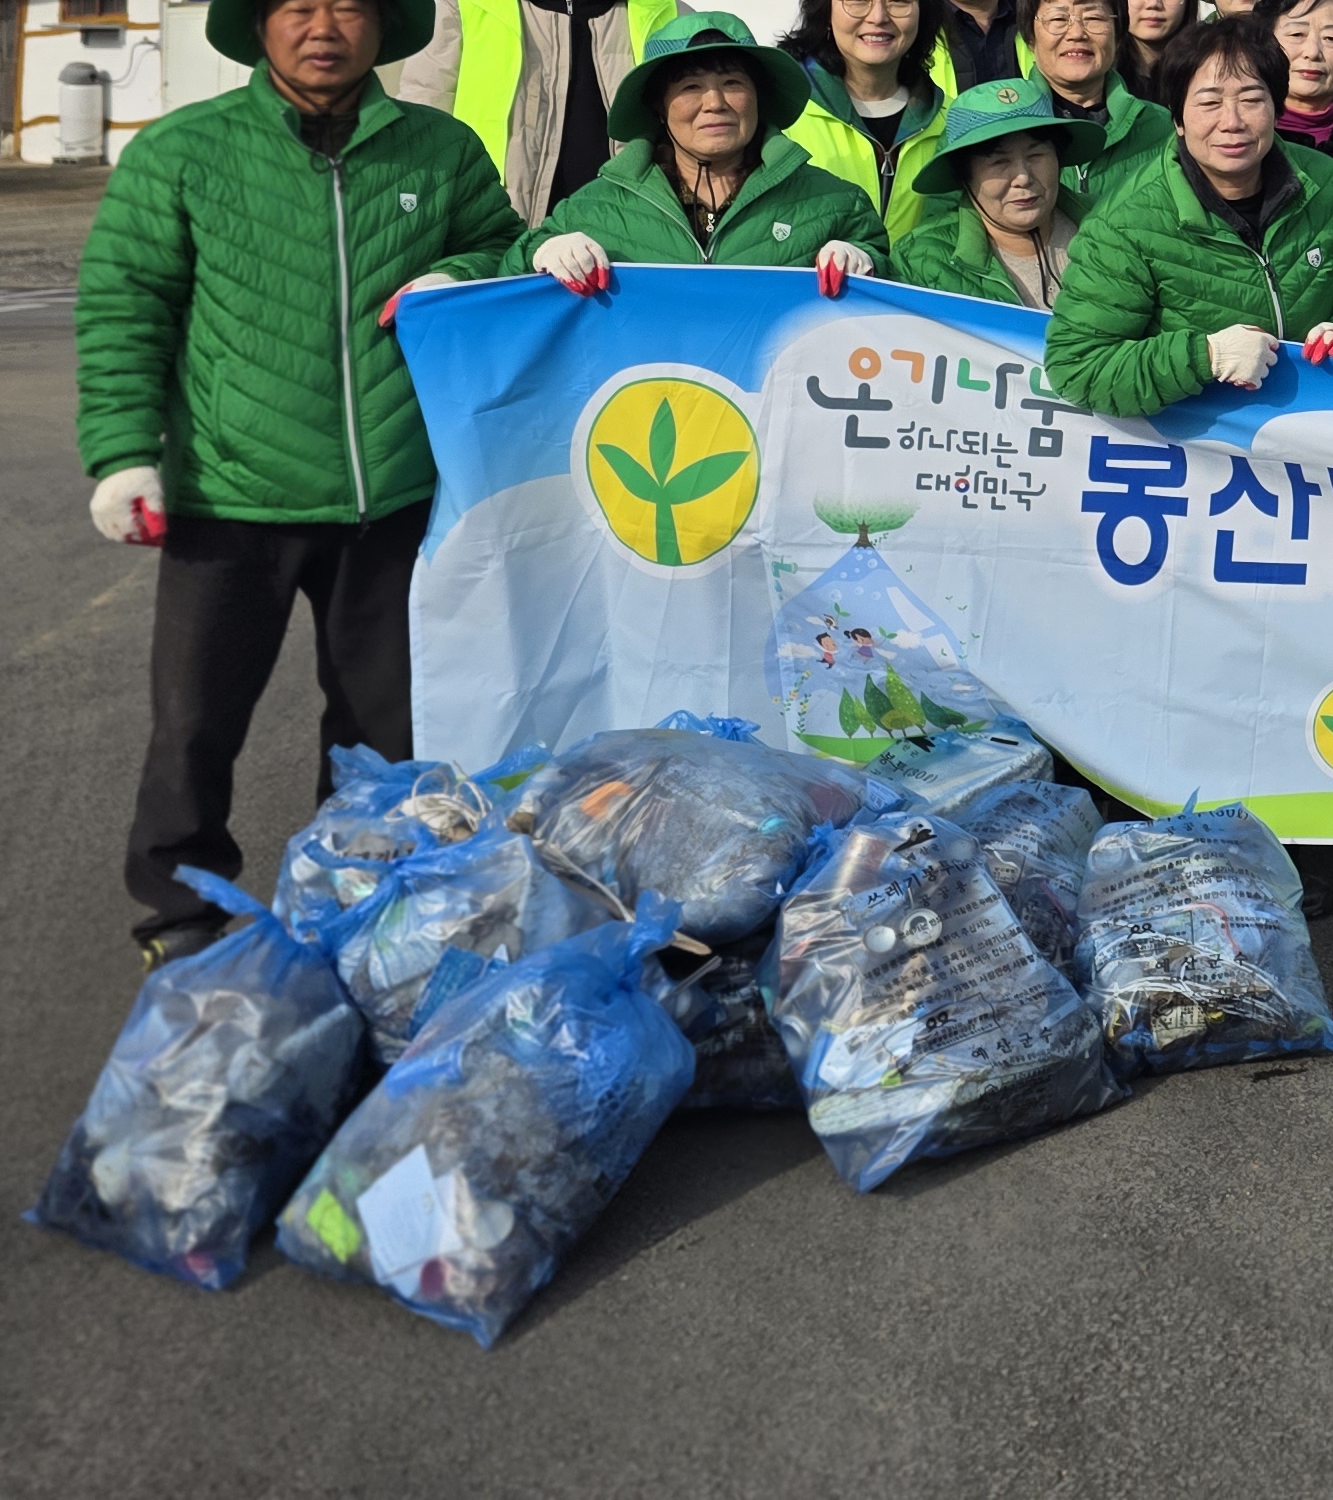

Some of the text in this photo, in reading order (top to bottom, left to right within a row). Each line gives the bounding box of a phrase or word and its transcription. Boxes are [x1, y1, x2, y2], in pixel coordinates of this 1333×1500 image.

[806, 346, 1094, 458] 온기나눔
[896, 421, 1018, 468] 하나되는
[916, 465, 1047, 512] 대한민국
